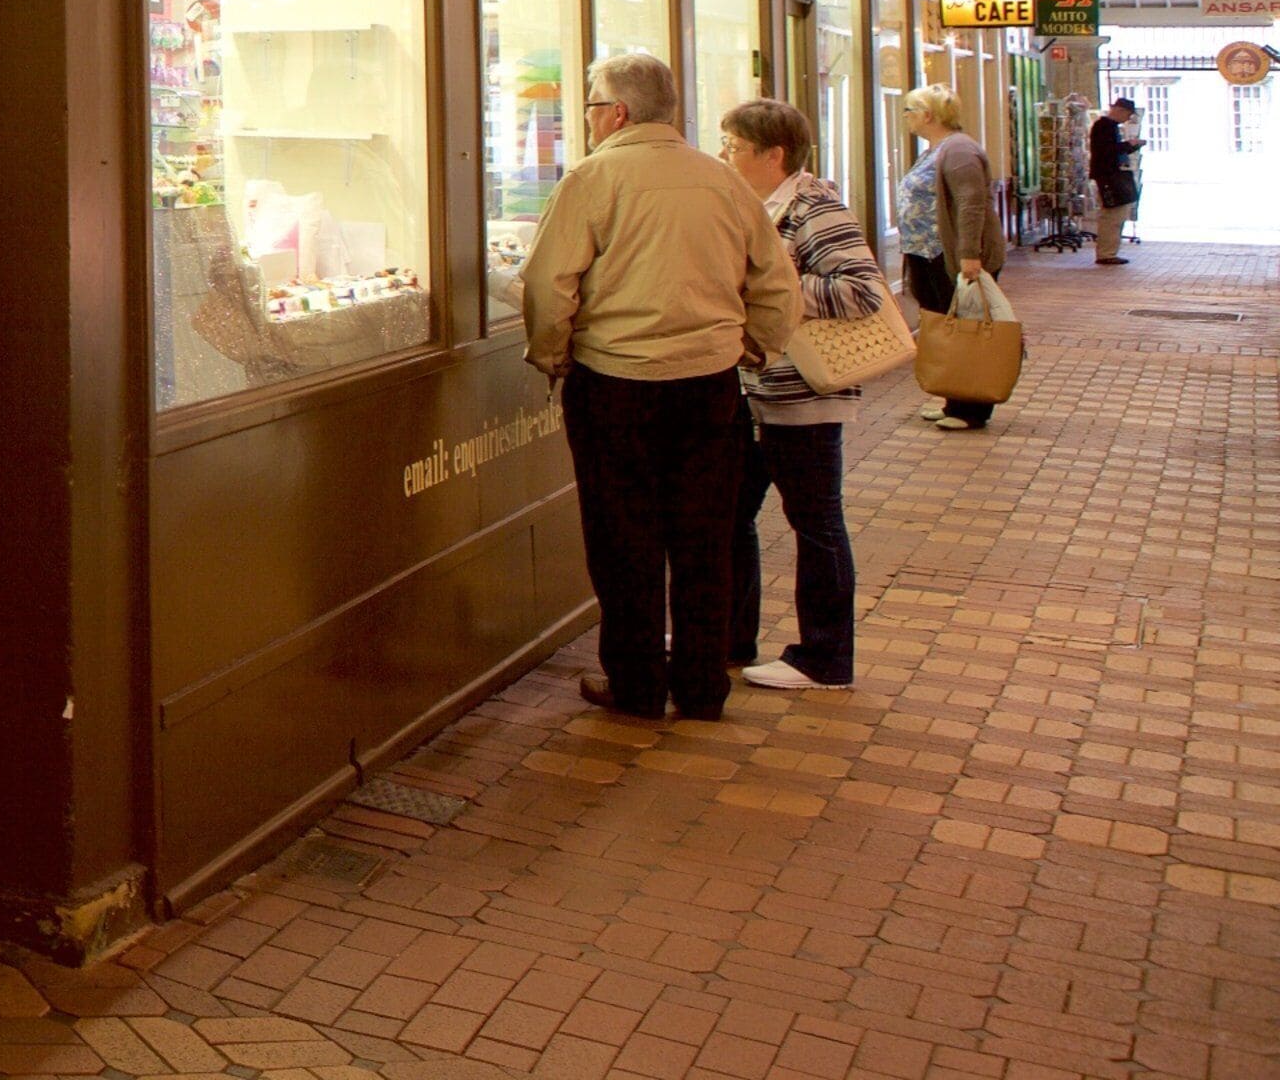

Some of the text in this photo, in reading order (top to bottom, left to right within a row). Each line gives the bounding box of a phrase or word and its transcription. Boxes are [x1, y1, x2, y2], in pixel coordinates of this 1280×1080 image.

[1049, 11, 1088, 22] AUTO
[1041, 23, 1096, 34] MODELS
[403, 438, 449, 498] email:
